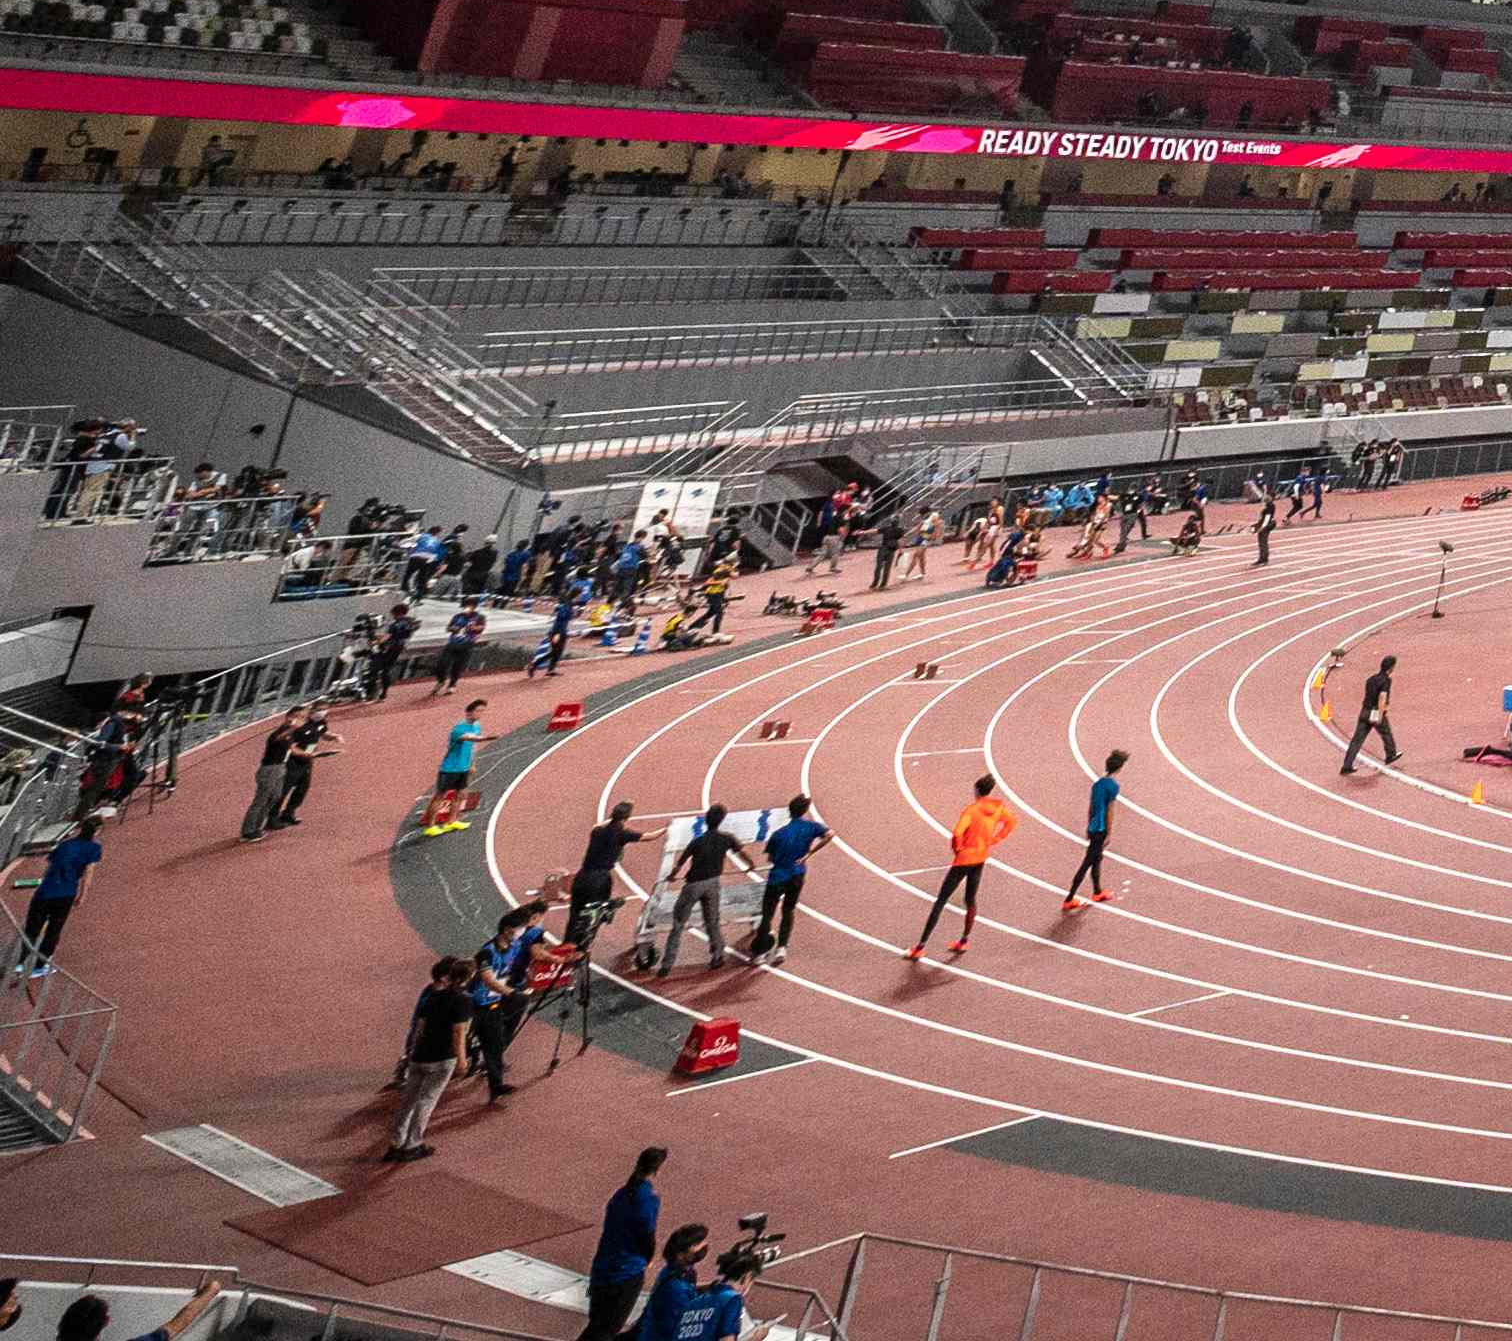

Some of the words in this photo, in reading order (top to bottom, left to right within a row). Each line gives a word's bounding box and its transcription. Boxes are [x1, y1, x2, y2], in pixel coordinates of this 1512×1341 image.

[978, 129, 1058, 155] READY
[1058, 133, 1149, 159] STEADY
[1150, 137, 1218, 162] TOKYO
[1222, 140, 1244, 153] Test
[1246, 141, 1282, 155] Events
[681, 1307, 715, 1325] TOKYO
